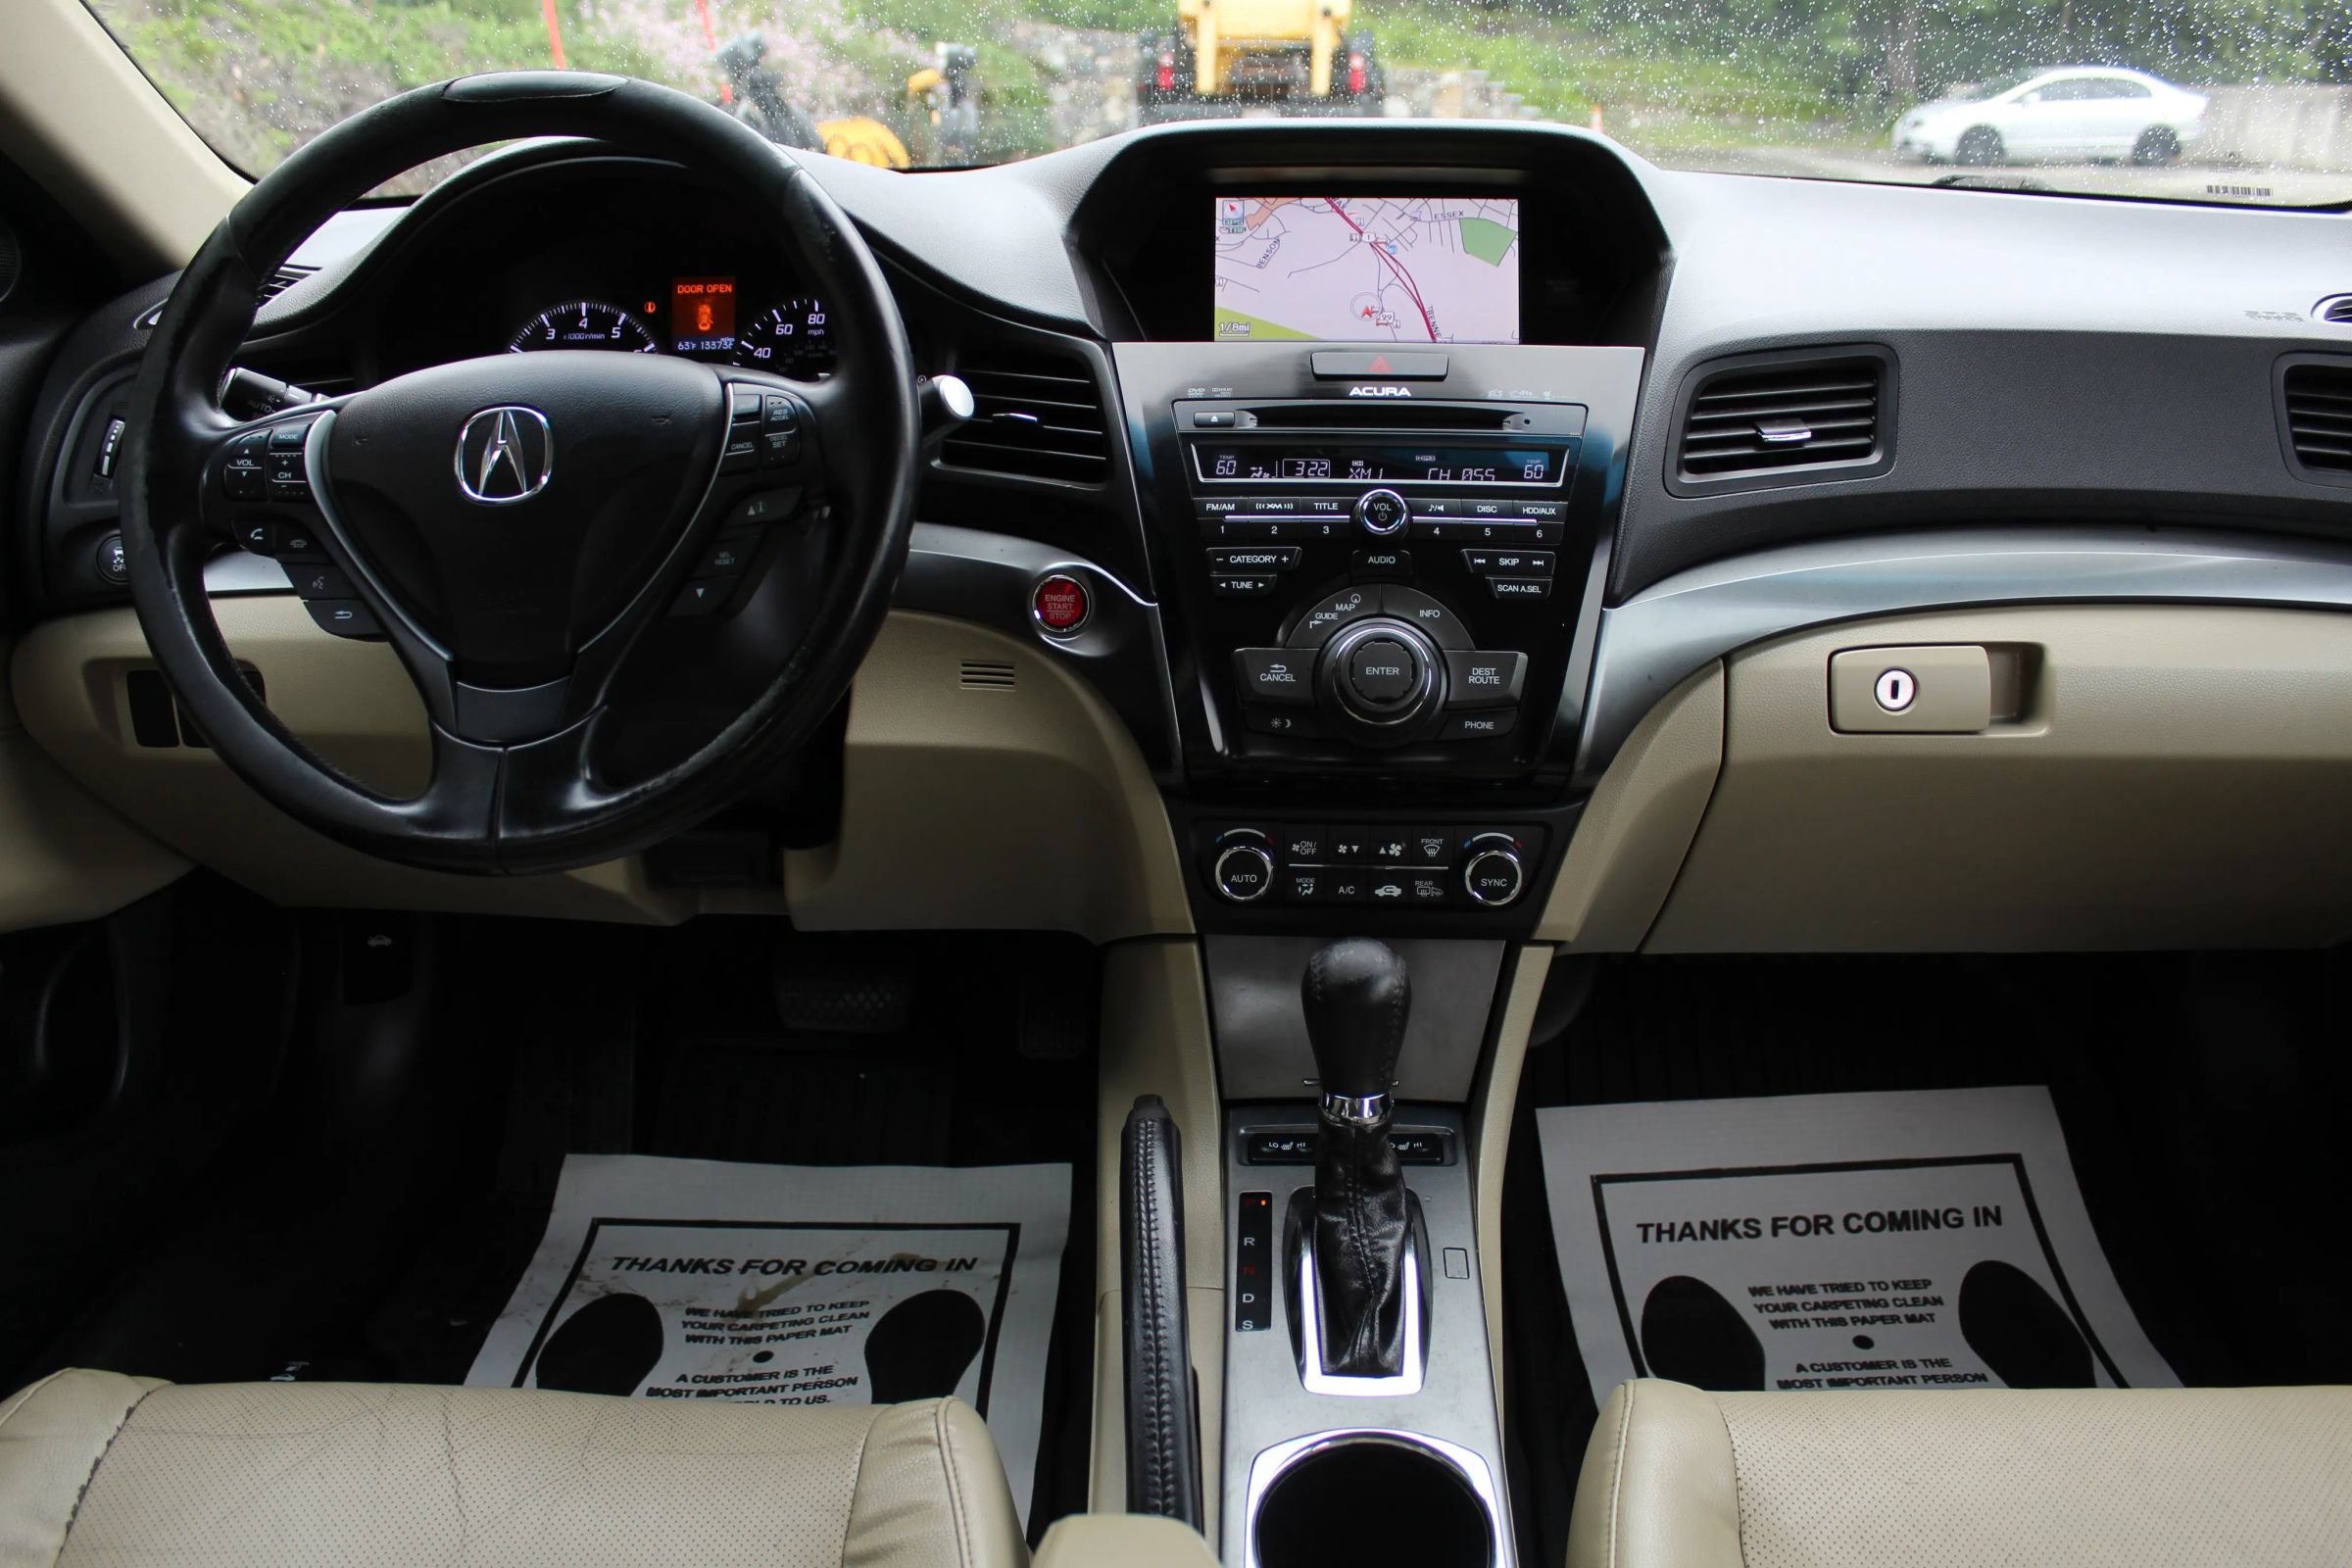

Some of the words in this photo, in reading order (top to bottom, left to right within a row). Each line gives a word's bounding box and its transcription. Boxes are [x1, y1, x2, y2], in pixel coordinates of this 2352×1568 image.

[1434, 211, 1464, 220] ESSEX
[1255, 237, 1280, 269] BENSON
[678, 284, 703, 293] DOOR
[707, 284, 732, 293] OPEN
[578, 318, 588, 329] 4
[808, 314, 825, 324] 80
[776, 324, 793, 334] 60
[1219, 322, 1250, 332] 1/8mi
[546, 328, 556, 340] 3
[612, 327, 621, 338] 5
[754, 347, 771, 359] 40
[1349, 386, 1411, 397] ACURA
[1215, 461, 1236, 475] 60
[1348, 467, 1372, 479] XM
[1523, 464, 1544, 479] 60
[1477, 505, 1497, 514] DISC
[1522, 507, 1556, 515] HDD/AUX
[1271, 525, 1278, 534] 2
[1323, 525, 1330, 534] 3
[1485, 527, 1492, 536] 5
[1536, 529, 1543, 538] 6
[1230, 555, 1277, 564] CATEGORY
[1498, 558, 1519, 566] SKIP
[1335, 603, 1355, 612] MAP
[1419, 610, 1441, 618] INFO
[1365, 666, 1399, 675] ENTER
[1472, 667, 1496, 676] DEST
[1259, 673, 1296, 682] CANCEL
[1464, 721, 1494, 730] PHONE
[1230, 874, 1257, 883] AUTO
[1481, 878, 1507, 887] SYNC
[1338, 886, 1355, 895] A/C
[1637, 1217, 1762, 1244] THANKS
[1771, 1214, 1835, 1238] FOR
[1842, 1207, 1964, 1234] COMING
[1973, 1205, 2002, 1228] IN
[1244, 1237, 1255, 1247] R
[612, 1256, 735, 1274] THANKS
[739, 1259, 808, 1275] FOR
[813, 1258, 938, 1276] COMING
[945, 1257, 978, 1272] IN
[1747, 1286, 1774, 1297] WE
[1777, 1284, 1817, 1296] HAVE
[1819, 1282, 1865, 1294] TRIED
[1868, 1281, 1889, 1292] TO
[1891, 1279, 1933, 1291] KEEP
[1242, 1293, 1255, 1303] D
[685, 1307, 710, 1317] WE
[713, 1308, 755, 1318] HAVE
[759, 1306, 802, 1318] TRIED
[807, 1303, 825, 1313] TO
[828, 1300, 869, 1311] KEEP
[1753, 1301, 1799, 1313] YOUR
[1801, 1298, 1889, 1312] CARPETING
[1892, 1296, 1944, 1308] CLEAN
[681, 1320, 725, 1331] YOUR
[727, 1316, 814, 1332] CARPETING
[818, 1311, 870, 1323] CLEAN
[1242, 1319, 1253, 1330] S
[1769, 1319, 1810, 1330] WITH
[1811, 1317, 1848, 1328] THIS
[1849, 1314, 1903, 1326] PAPER
[1904, 1312, 1936, 1324] MAT
[685, 1334, 725, 1345] WITH
[728, 1335, 762, 1345] THIS
[765, 1329, 816, 1344] PAPER
[819, 1325, 853, 1336] MAT
[1795, 1363, 1808, 1373] A
[1809, 1359, 1899, 1373] CUSTOMER
[1901, 1359, 1918, 1369] IS
[1919, 1358, 1952, 1368] THE
[675, 1374, 688, 1383] A
[691, 1371, 781, 1384] CUSTOMER
[783, 1369, 799, 1379] IS
[803, 1365, 834, 1376] THE
[1776, 1378, 1824, 1390] MOST
[1827, 1375, 1918, 1388] IMPORTANT
[1919, 1373, 1988, 1385] PERSON
[646, 1387, 695, 1398] MOST
[696, 1384, 790, 1398] IMPORTANT
[792, 1376, 858, 1392] PERSON
[805, 1395, 831, 1405] US.
